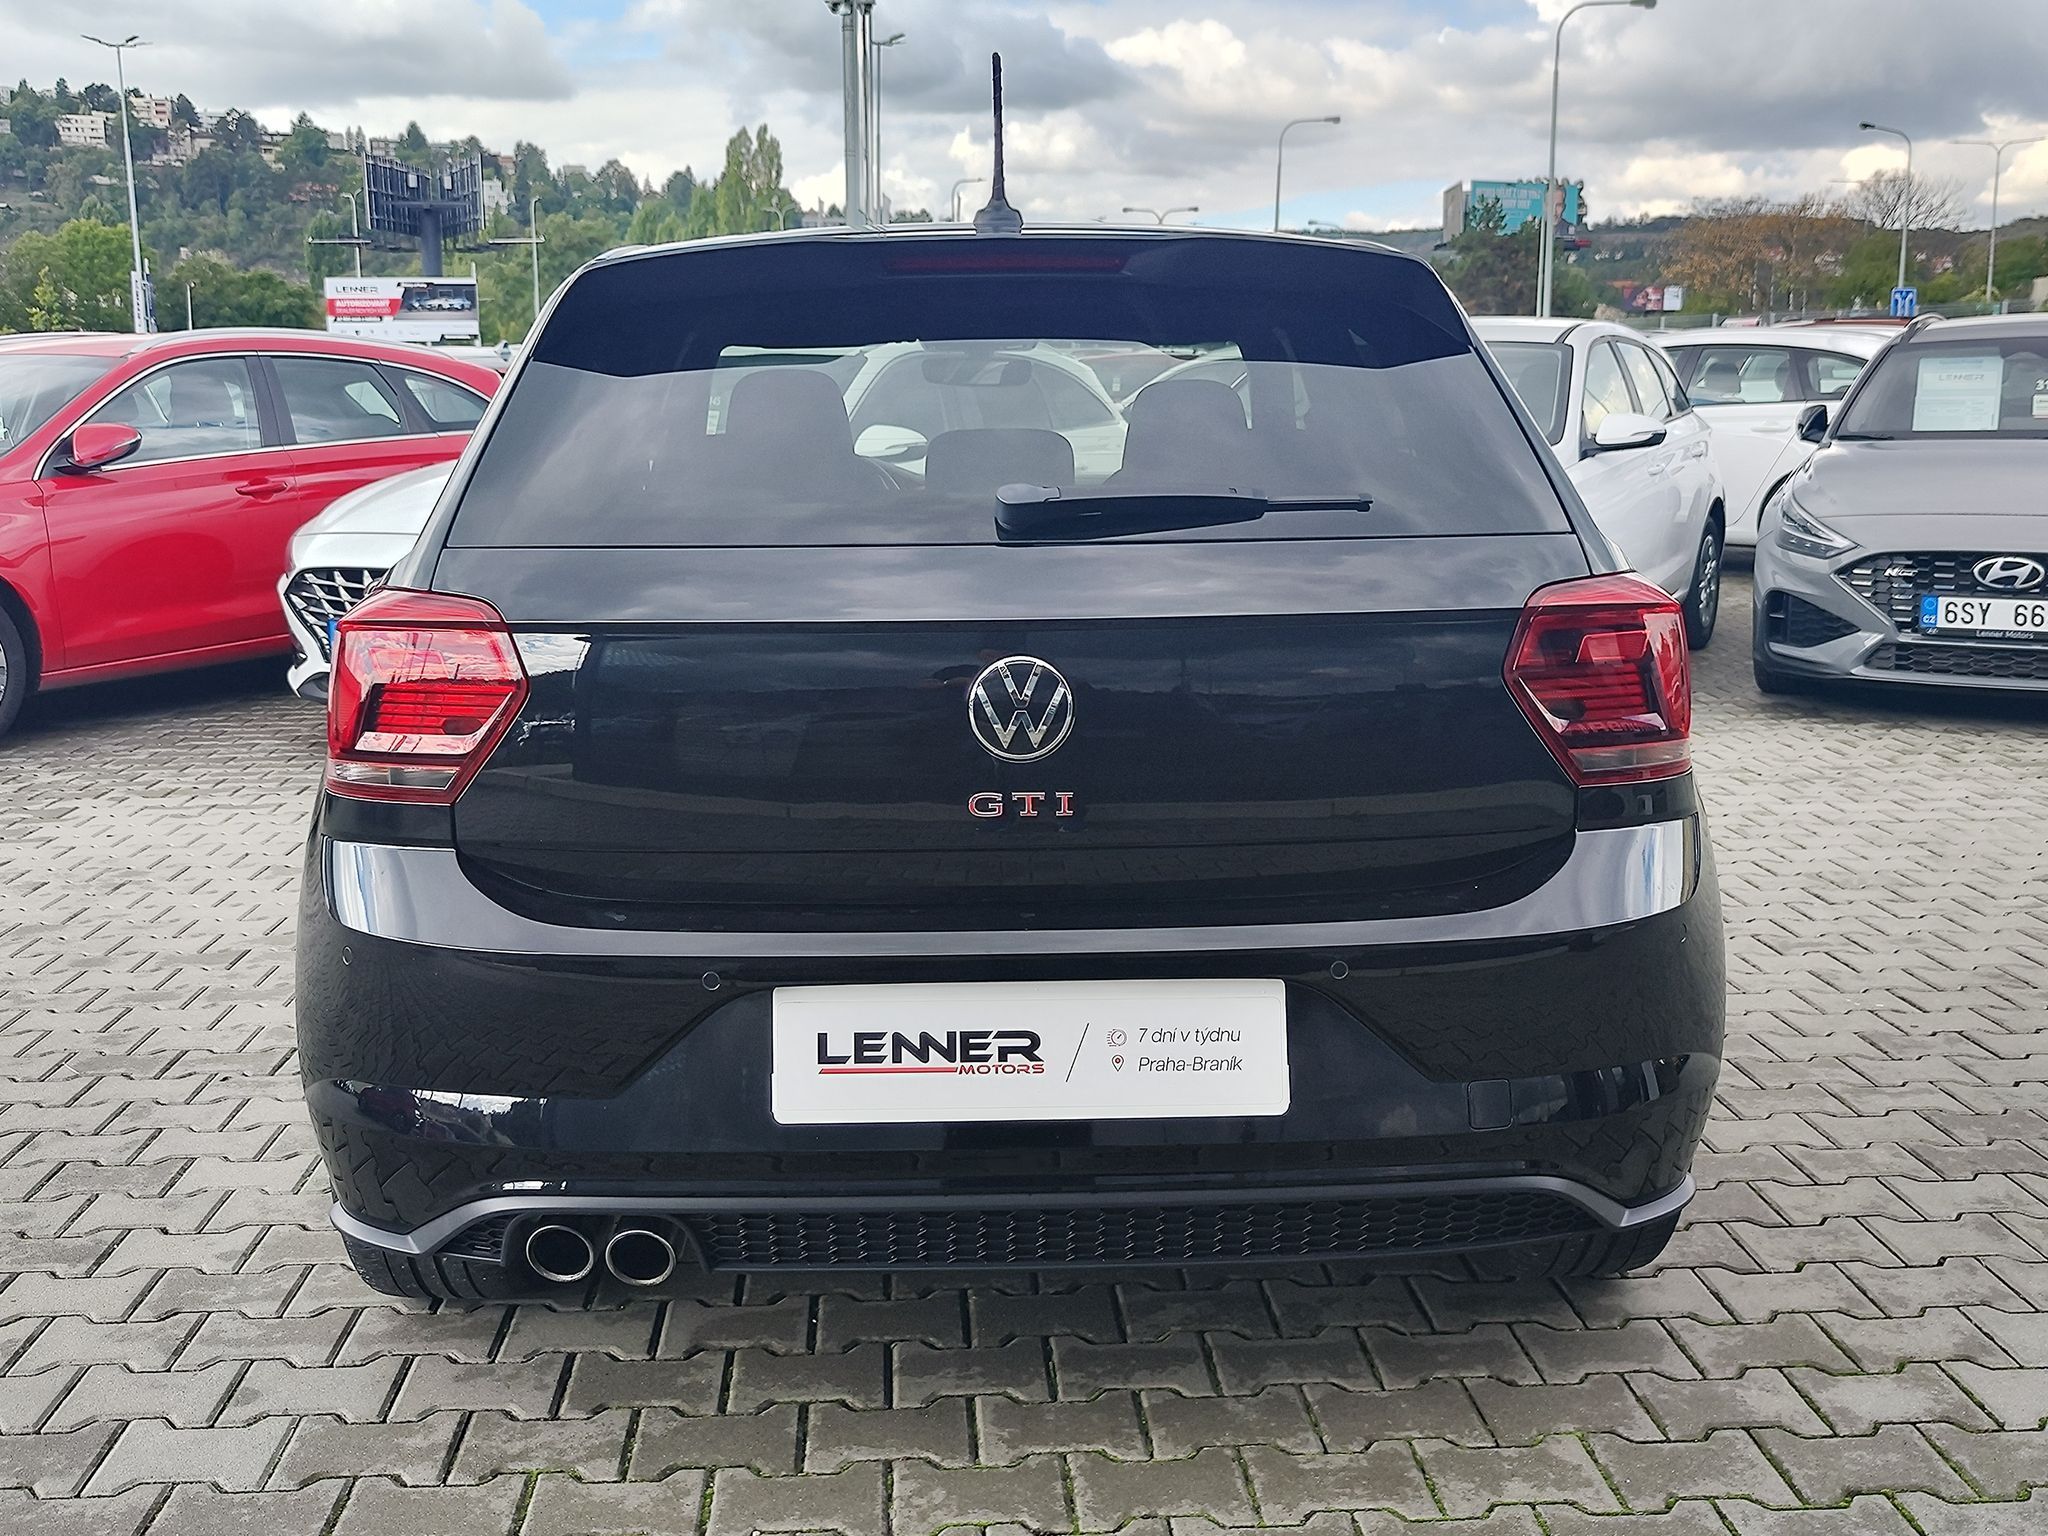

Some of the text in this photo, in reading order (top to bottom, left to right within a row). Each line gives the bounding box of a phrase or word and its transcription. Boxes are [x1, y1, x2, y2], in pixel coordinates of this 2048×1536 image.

[335, 286, 380, 294] LENNER
[1922, 614, 1936, 623] CZ
[1945, 602, 2045, 627] 6SY 66
[968, 791, 1074, 818] GTI
[1138, 1026, 1241, 1046] 7 dní v týdnu
[817, 1030, 1045, 1065] LENNER
[958, 1063, 1045, 1075] MOTORS
[1138, 1055, 1243, 1072] Praha-Braník
